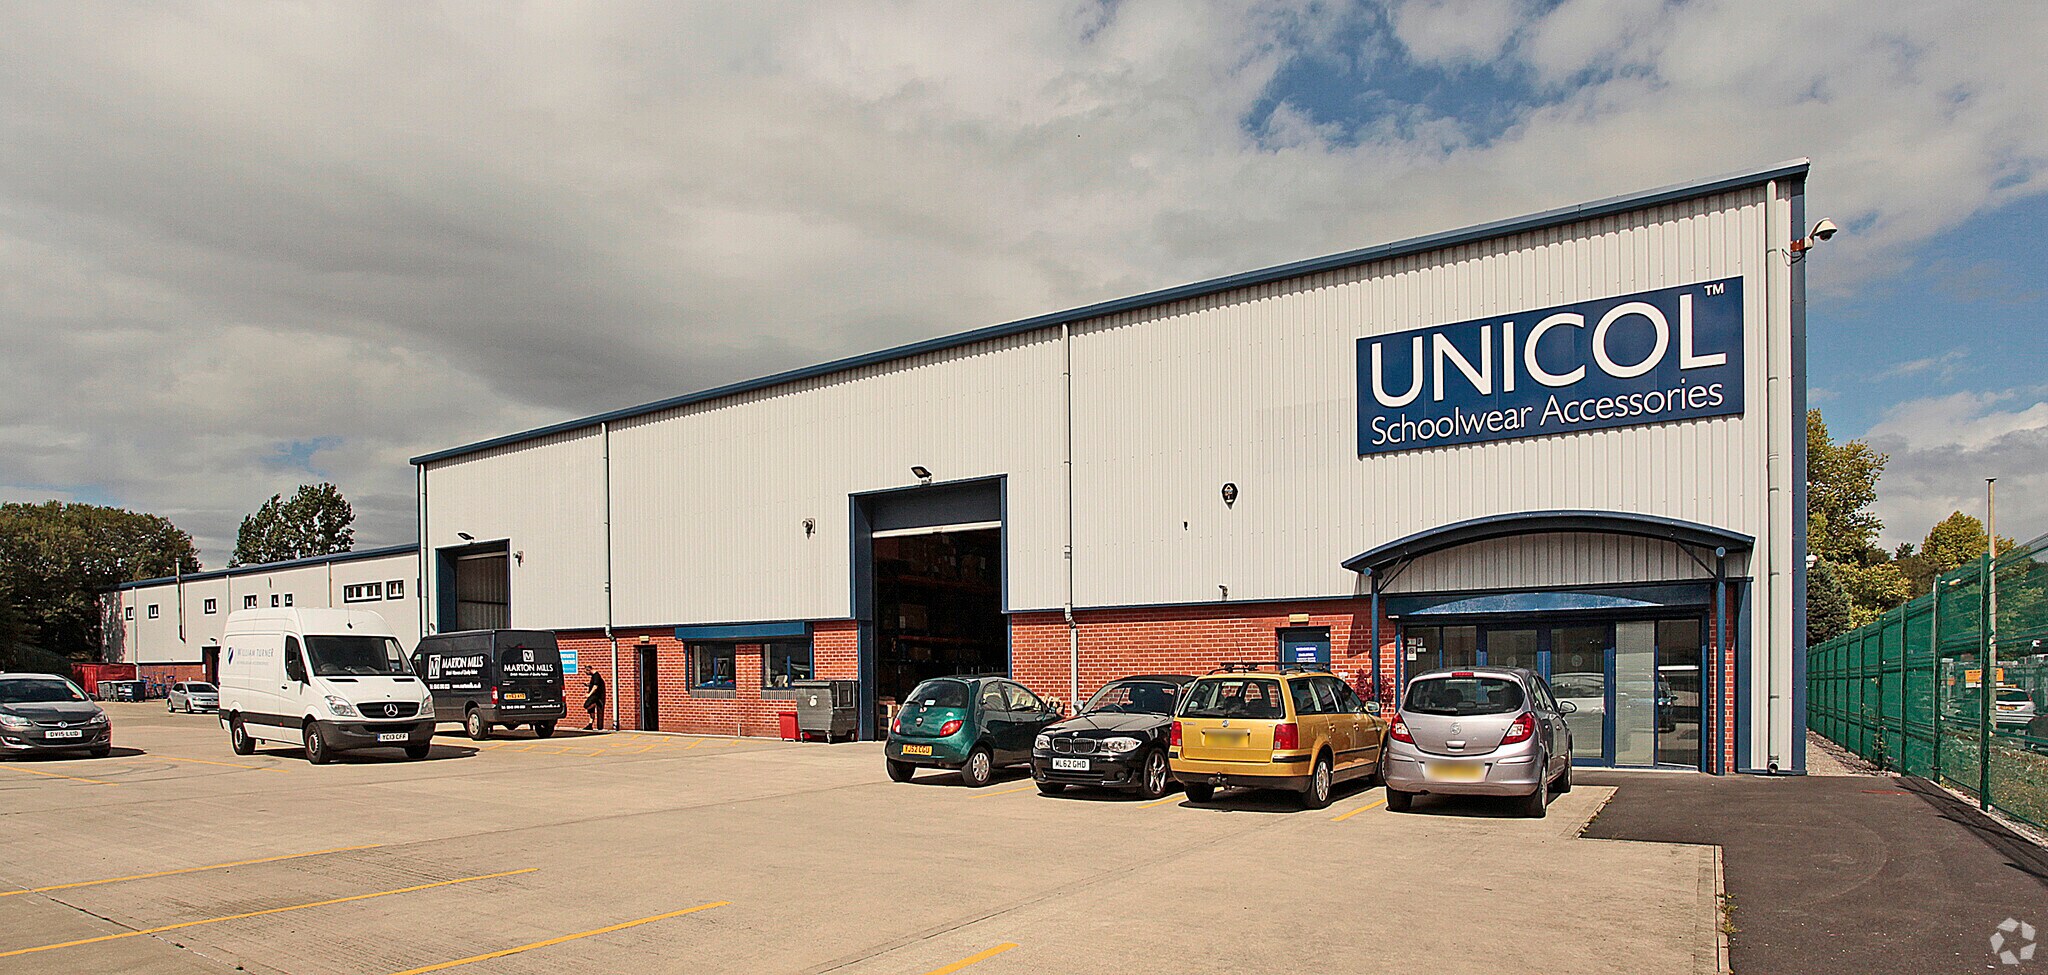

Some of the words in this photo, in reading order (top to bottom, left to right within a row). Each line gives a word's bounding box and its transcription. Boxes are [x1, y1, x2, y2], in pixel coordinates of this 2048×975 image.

[1371, 292, 1727, 407] UNICOL
[1704, 283, 1724, 296] TM
[1371, 406, 1533, 446] Schoolwear
[1539, 378, 1724, 427] Accessories
[441, 657, 467, 669] MARTON
[467, 655, 484, 668] MILLS
[503, 663, 535, 671] MARTON
[536, 663, 554, 671] MILLS
[1072, 760, 1086, 769] GHD
